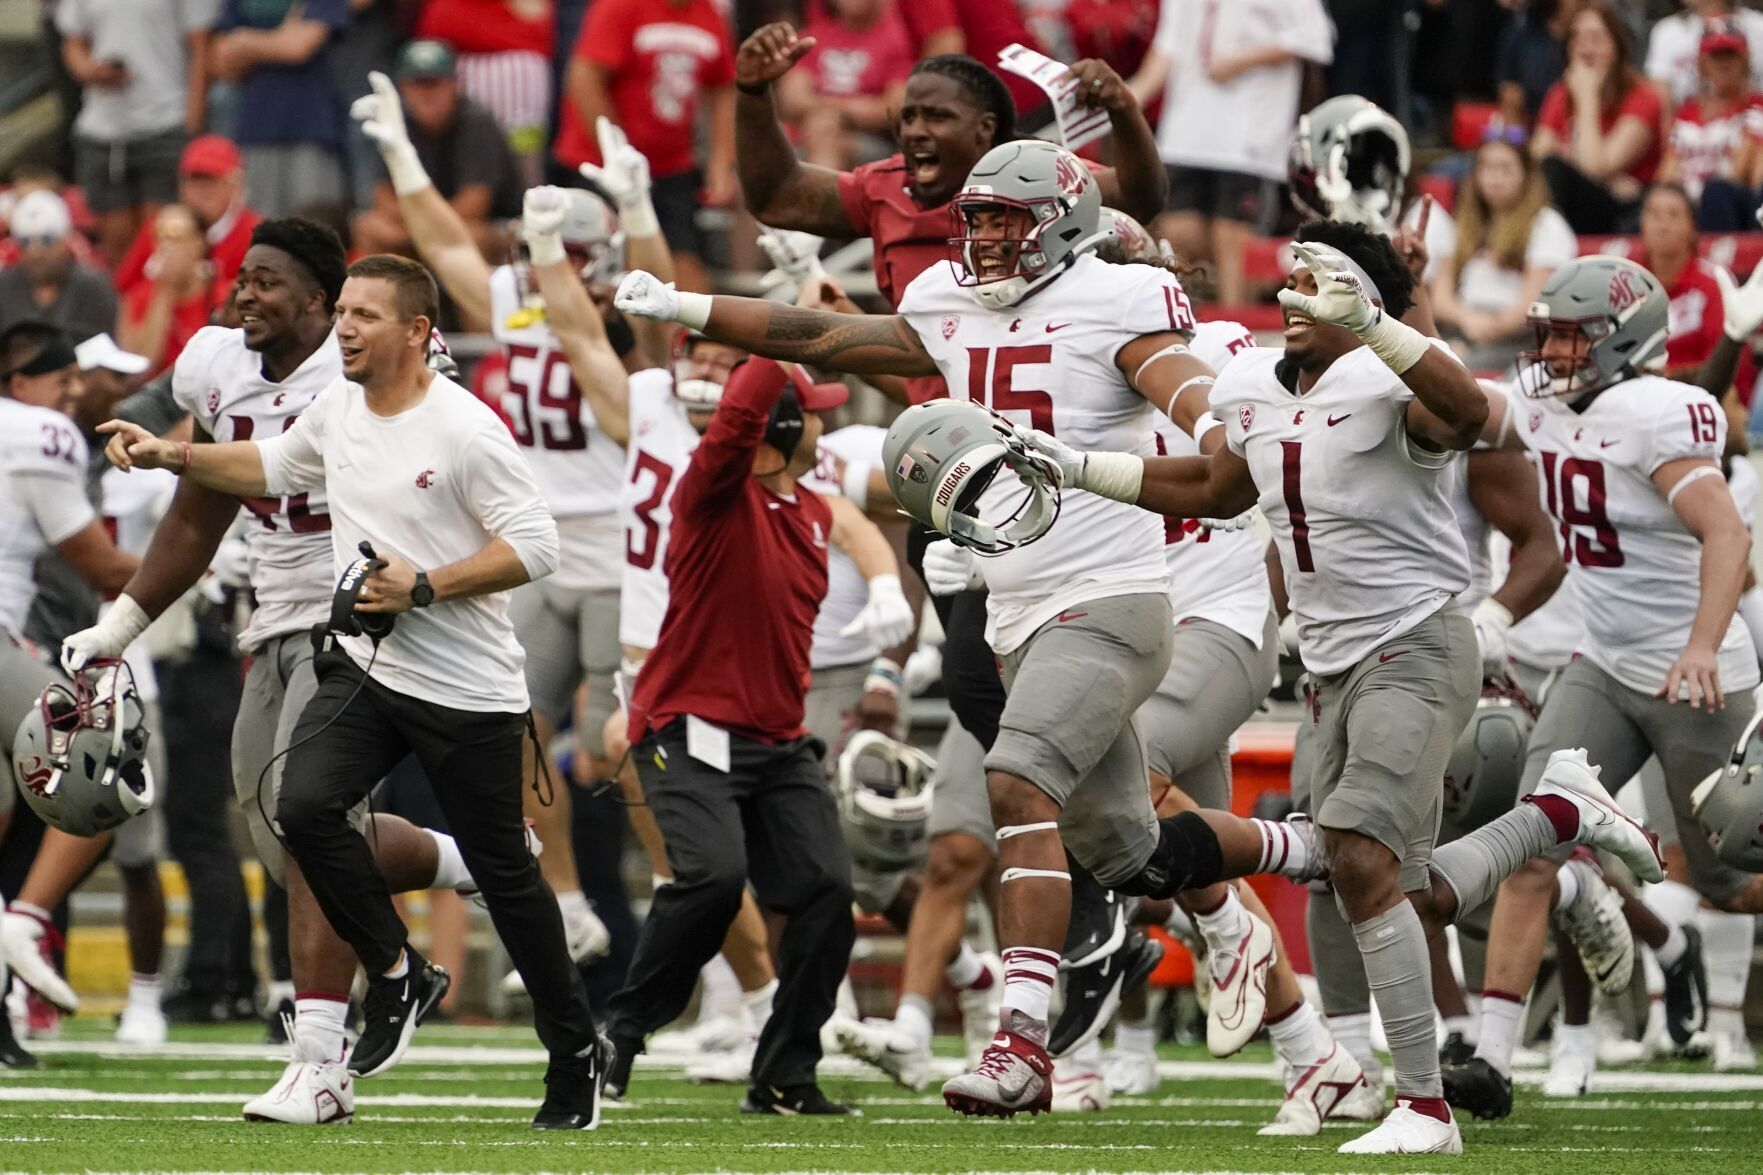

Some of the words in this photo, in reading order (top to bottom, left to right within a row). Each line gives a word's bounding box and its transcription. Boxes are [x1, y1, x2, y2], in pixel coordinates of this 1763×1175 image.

[1162, 285, 1194, 330] 15
[508, 343, 588, 450] 59
[1687, 403, 1717, 443] 19
[936, 462, 971, 507] COUGARS
[1280, 441, 1316, 573] 1
[1540, 451, 1625, 568] 19
